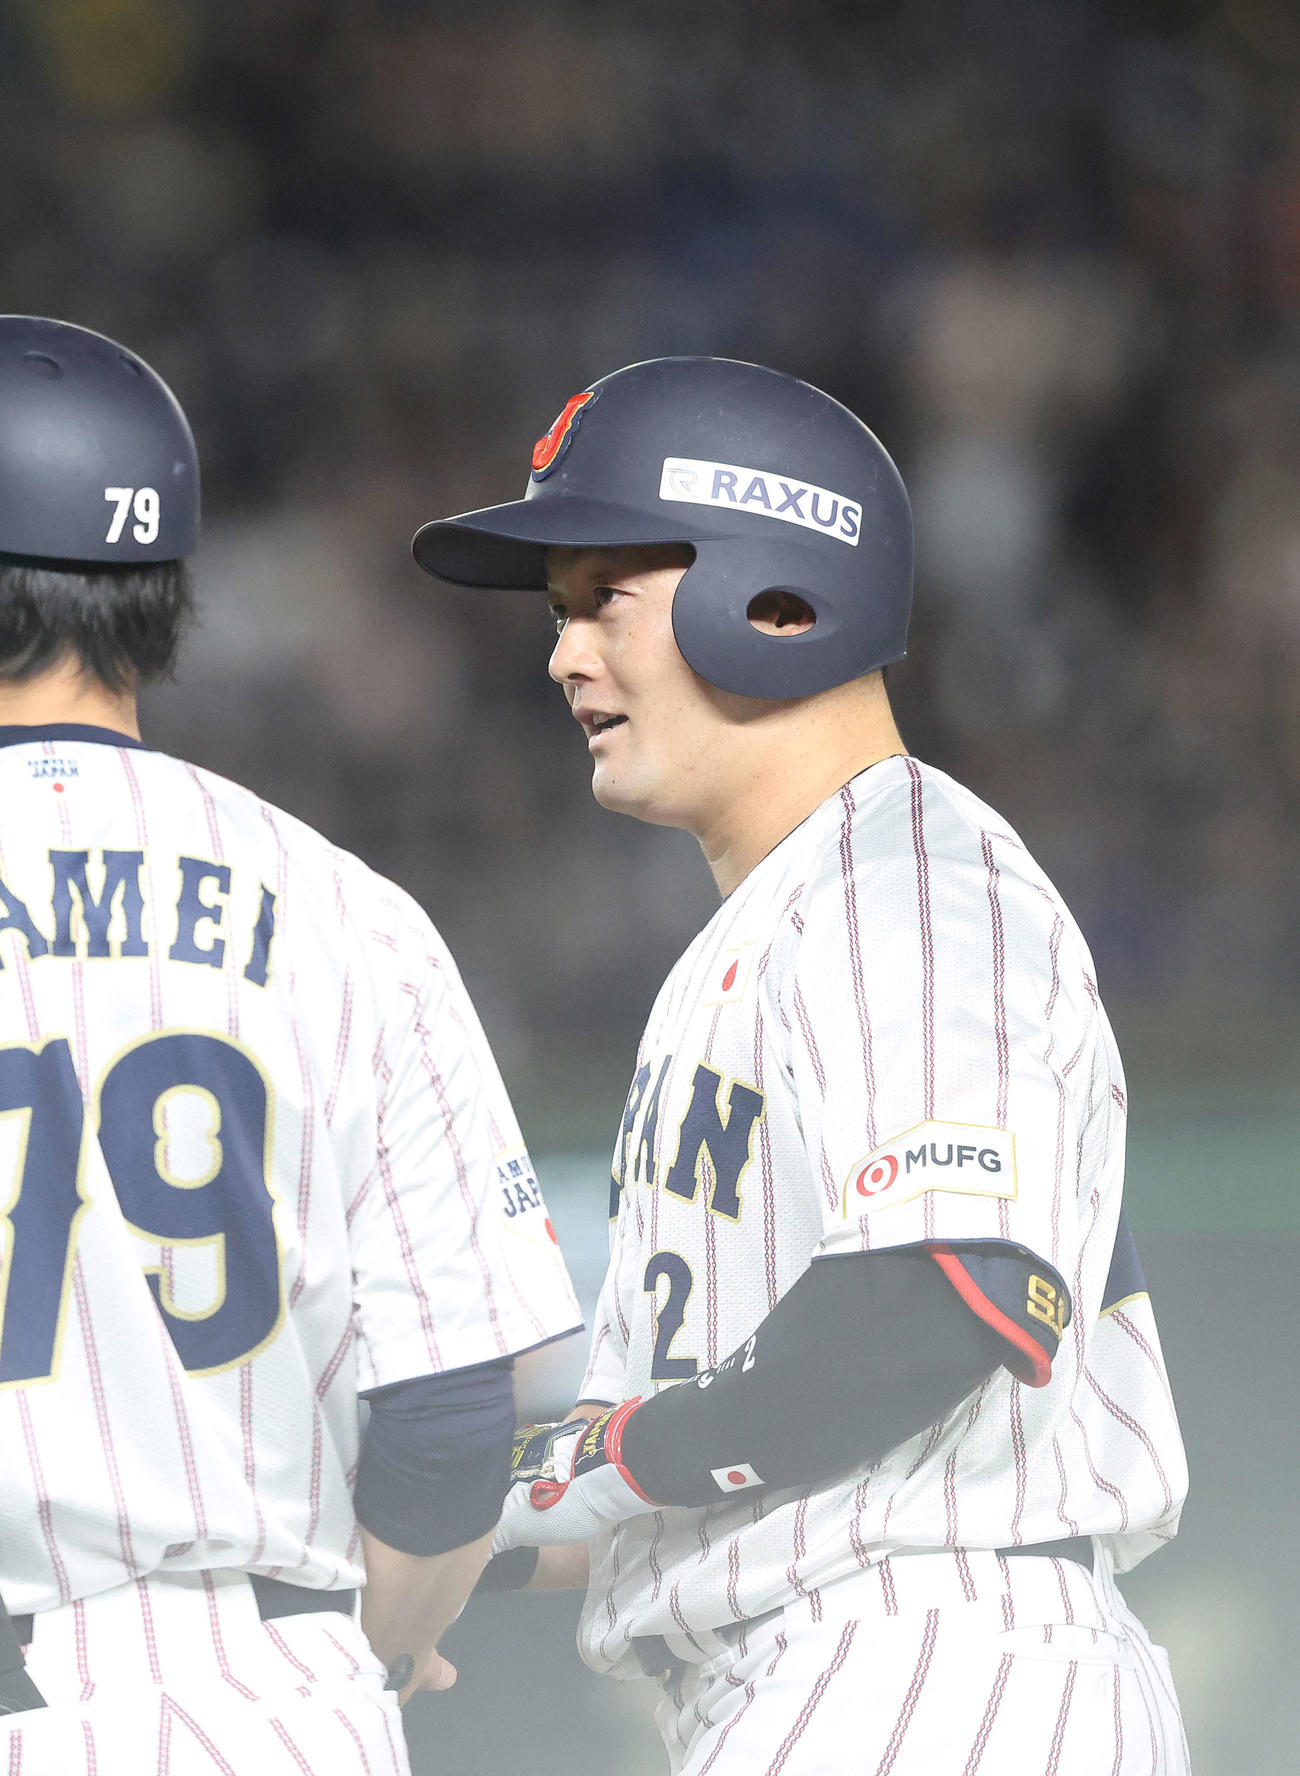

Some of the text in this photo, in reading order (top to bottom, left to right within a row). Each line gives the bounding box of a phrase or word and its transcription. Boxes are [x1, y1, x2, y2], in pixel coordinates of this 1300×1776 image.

[104, 487, 160, 545] 79
[711, 469, 859, 538] RAXUS
[905, 1143, 1002, 1174] MUFG
[0, 1026, 285, 1389] 79
[643, 1250, 699, 1382] 2
